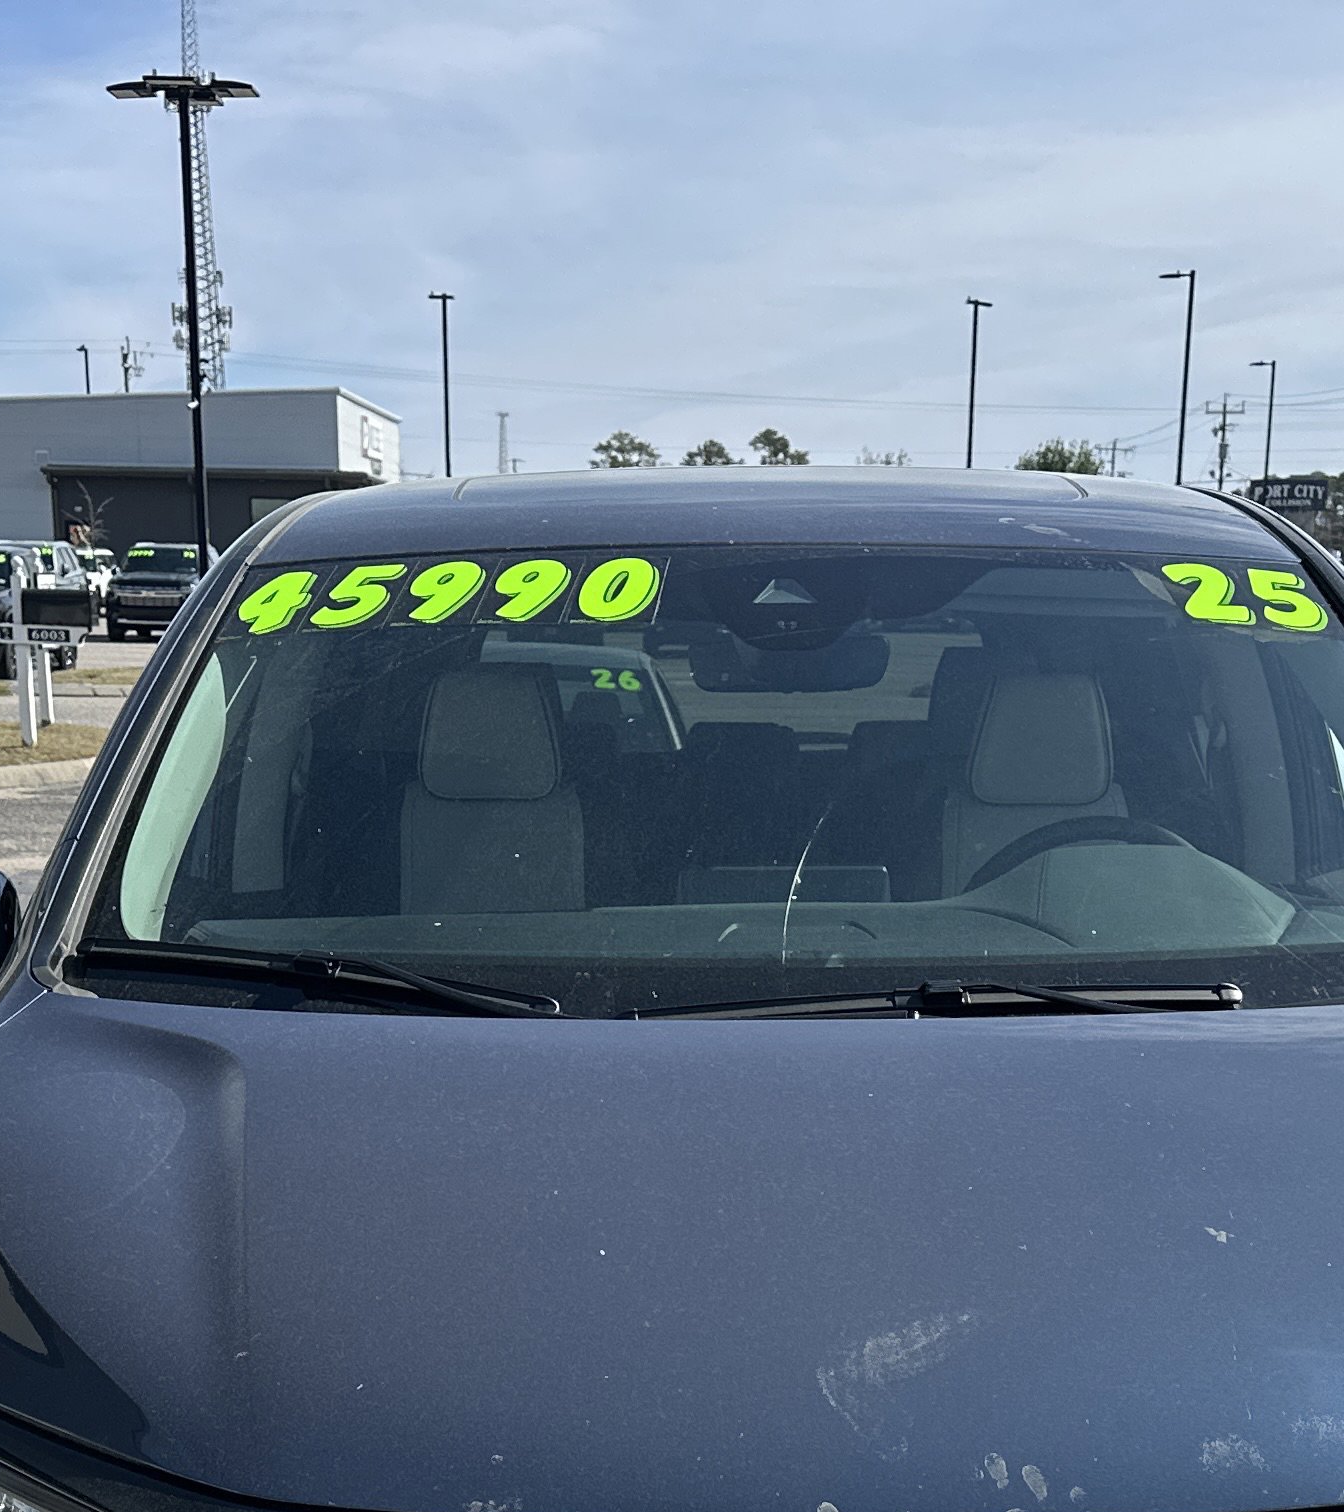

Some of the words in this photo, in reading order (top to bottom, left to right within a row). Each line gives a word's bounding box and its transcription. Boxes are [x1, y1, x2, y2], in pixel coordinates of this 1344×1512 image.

[1294, 484, 1325, 500] CITY
[239, 557, 660, 635] 45990
[1161, 563, 1329, 632] 25
[31, 630, 66, 641] 6003
[591, 669, 641, 690] 26
